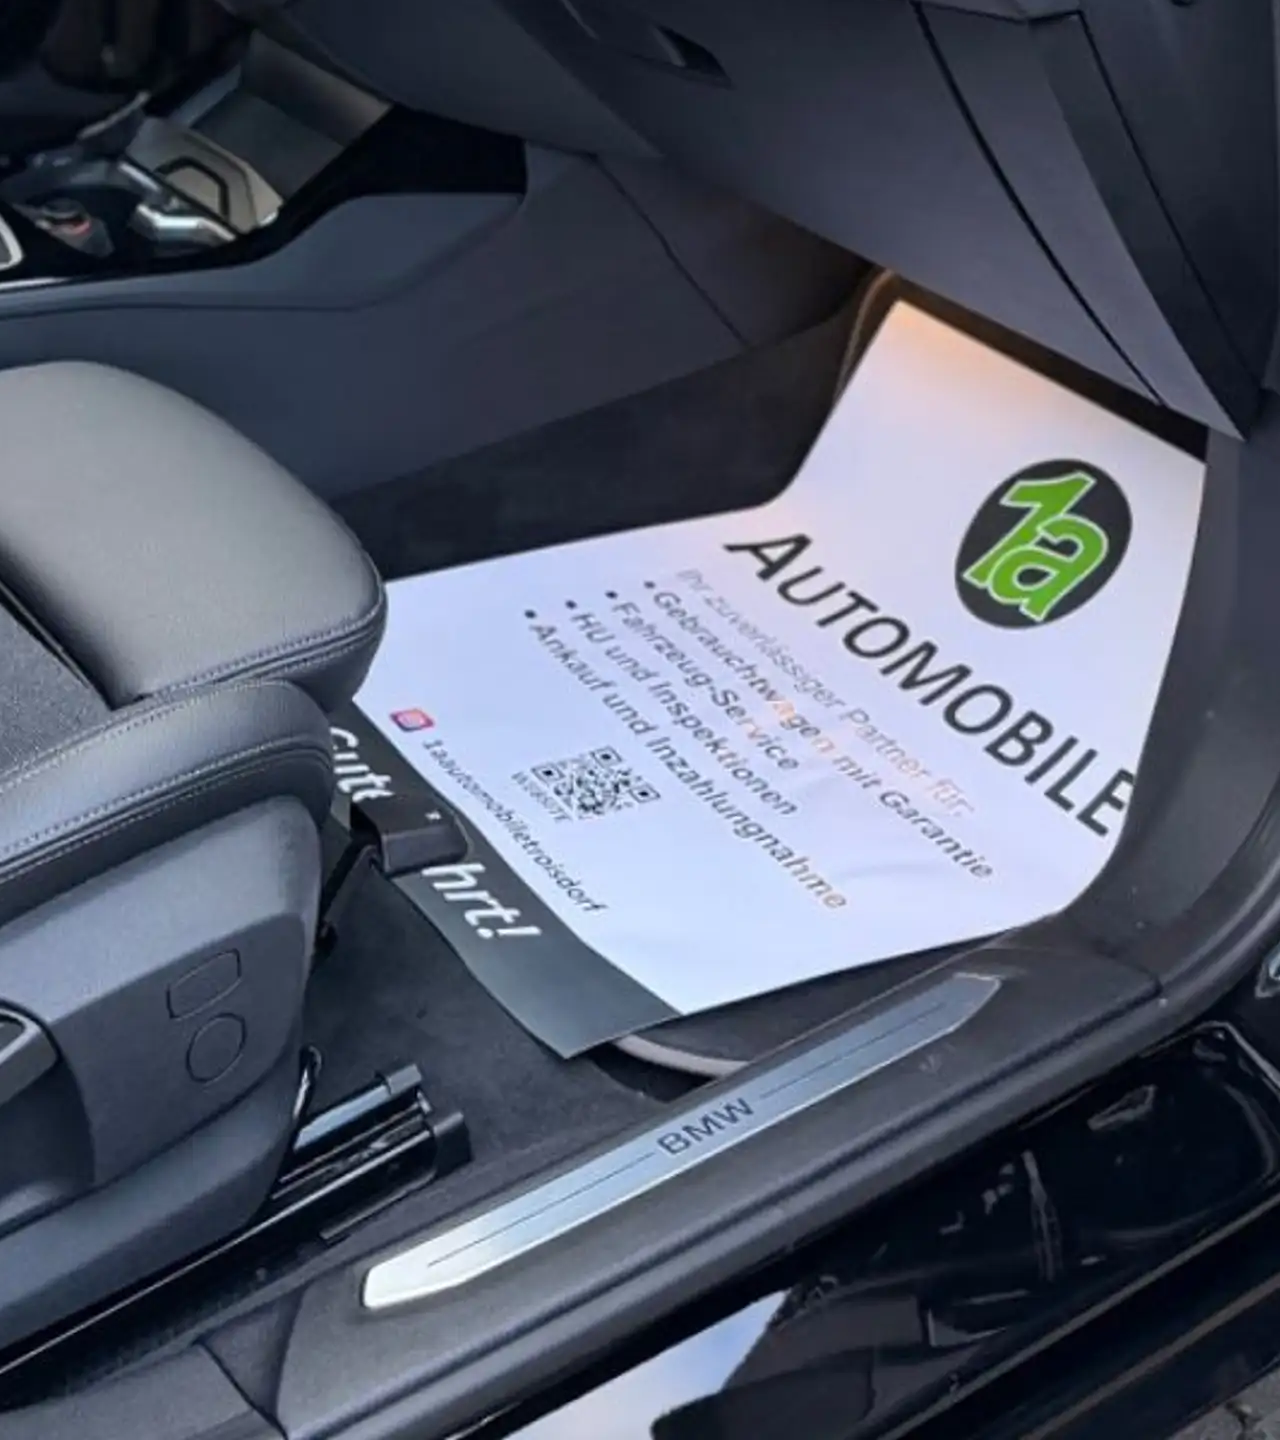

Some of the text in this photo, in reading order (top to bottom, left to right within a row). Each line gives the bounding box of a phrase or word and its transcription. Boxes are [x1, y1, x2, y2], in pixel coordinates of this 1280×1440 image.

[962, 470, 1110, 621] 1a
[529, 624, 617, 691] Ankauf
[602, 693, 659, 735] und
[645, 735, 847, 910] Inzahlungnahme
[570, 612, 797, 815] HU und Inspektionen
[611, 602, 799, 770] Fahrzeug-Service
[653, 591, 993, 877] Gebrauchtwagen mit Garantie
[723, 533, 1135, 837] AUTOMOBILE
[839, 709, 931, 779] Partner
[656, 1097, 755, 1155] BMW
